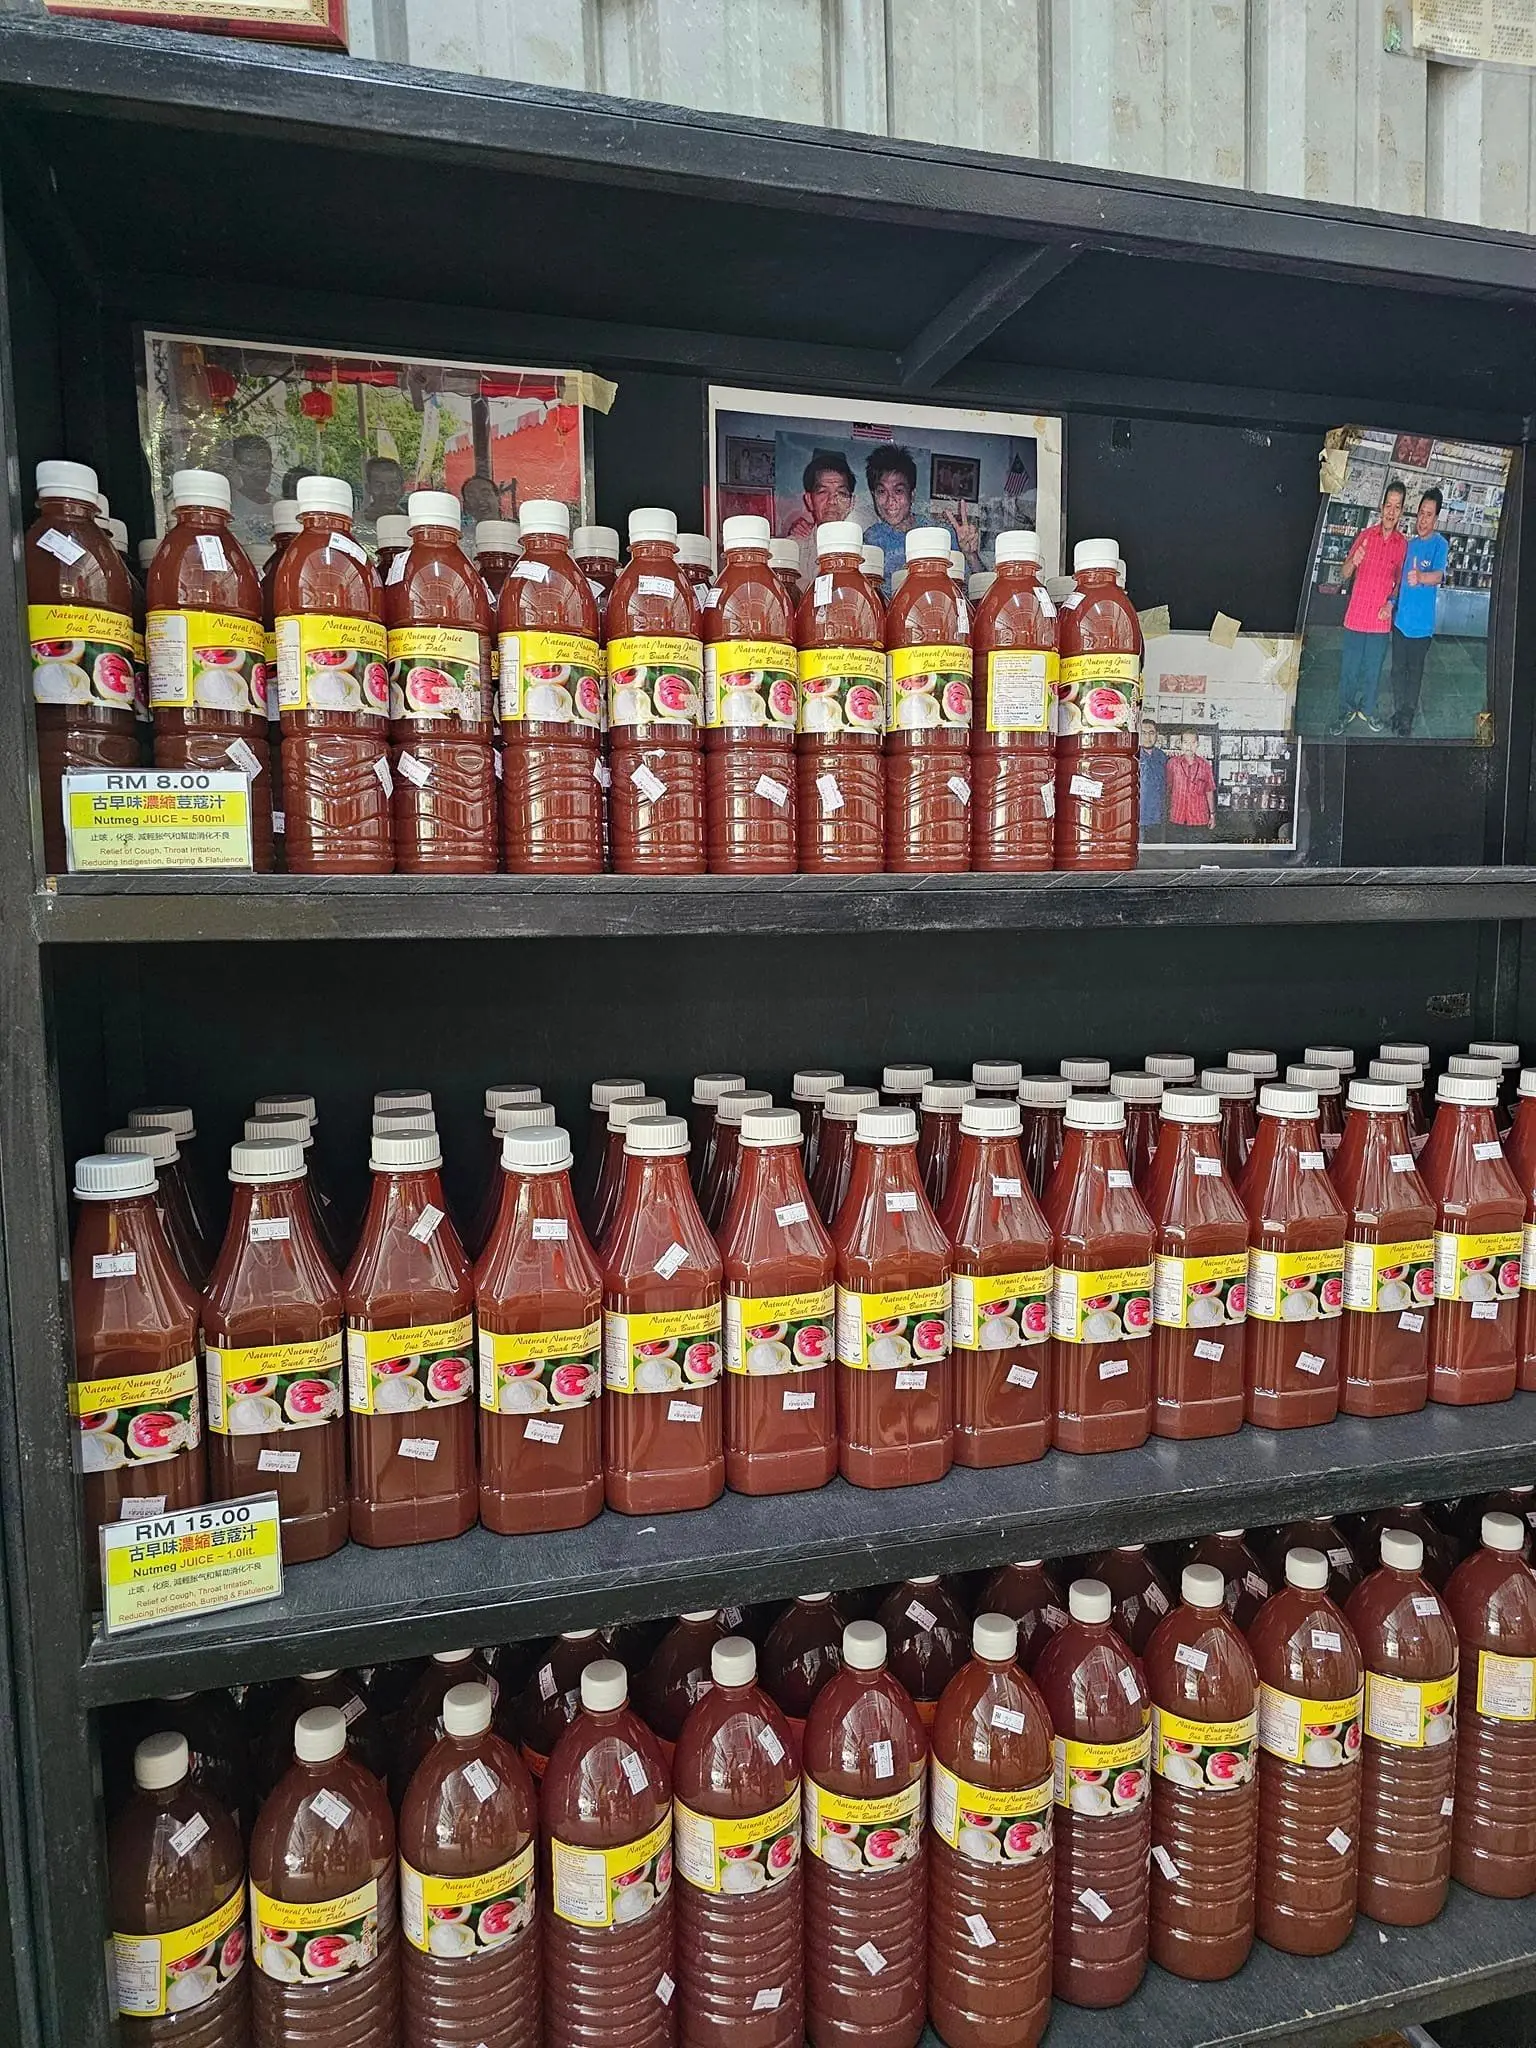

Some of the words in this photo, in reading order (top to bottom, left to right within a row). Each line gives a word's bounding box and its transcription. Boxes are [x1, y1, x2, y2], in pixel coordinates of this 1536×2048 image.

[46, 609, 88, 622] Natural
[90, 611, 122, 629] Nutmeg
[323, 619, 361, 633] Natural
[65, 623, 83, 635] Jus
[88, 625, 112, 637] Buah
[340, 634, 357, 645] Jus
[404, 631, 436, 645] Nutmeg
[438, 633, 463, 643] Juice
[425, 643, 447, 653] Pala
[619, 641, 650, 652] Natural
[651, 641, 682, 653] Nutmeg
[649, 652, 670, 661] Buah
[813, 652, 844, 662] Natural
[909, 650, 941, 660] Natural
[107, 775, 147, 790] RM
[156, 775, 210, 789] 8.00
[92, 795, 226, 811] 古早味濃縮荳蔻汁
[94, 815, 139, 826] Nutmeg
[142, 814, 178, 824] JUICE
[191, 814, 225, 823] 500ml
[100, 847, 123, 855] Relief
[125, 847, 133, 855] of
[134, 847, 162, 856] Cough,
[164, 846, 188, 854] Throat
[190, 846, 223, 854] Irritation,
[82, 859, 118, 867] Reducing
[121, 858, 164, 867] Indigestion,
[166, 857, 196, 866] Burping
[205, 856, 244, 864] Flatulence
[759, 1298, 791, 1310] Natural
[791, 1296, 819, 1308] Nutmeg
[880, 1294, 910, 1305] Natural
[911, 1291, 938, 1303] Nutmeg
[773, 1309, 787, 1319] Jus
[790, 1308, 808, 1316] Buah
[893, 1303, 907, 1313] Jus
[909, 1301, 927, 1309] Buah
[649, 1314, 681, 1326] Natural
[682, 1311, 711, 1324] Nutmeg
[387, 1330, 424, 1343] Natural
[425, 1326, 457, 1340] Nutmeg
[663, 1325, 678, 1335] Jus
[680, 1323, 700, 1332] Buah
[403, 1342, 419, 1352] Jus
[422, 1338, 443, 1348] Buah
[513, 1334, 548, 1346] Natural
[549, 1332, 582, 1345] Nutmeg
[243, 1350, 282, 1363] Natural
[284, 1346, 319, 1359] Nutmeg
[529, 1346, 544, 1356] Jus
[548, 1343, 568, 1353] Buah
[261, 1360, 276, 1372] Jus
[281, 1358, 304, 1368] Buah
[308, 1354, 328, 1365] Pala
[80, 1383, 121, 1397] Natural
[123, 1377, 161, 1391] Nutmeg
[163, 1368, 187, 1385] Juice
[98, 1393, 116, 1406] Jus
[121, 1390, 145, 1401] Buah
[149, 1386, 172, 1397] Pala
[136, 1520, 175, 1541] RM
[185, 1507, 250, 1532] 15.00
[129, 1525, 258, 1562] 古早味濃縮荳蔻汁
[133, 1563, 177, 1578] Nutmeg
[180, 1553, 214, 1569] JUICE
[228, 1547, 256, 1559] 1.0lit.
[136, 1597, 158, 1608] Relief
[160, 1595, 168, 1604] of
[169, 1590, 197, 1602] Cough,
[199, 1585, 222, 1596] Throat
[223, 1578, 254, 1591] Irritation,
[118, 1608, 154, 1622] Reducing
[156, 1600, 199, 1615] Indigestion,
[200, 1593, 229, 1606] Burping
[230, 1590, 236, 1598] &
[237, 1584, 274, 1597] Flatulence
[1176, 1720, 1205, 1731] Natural
[1084, 1745, 1114, 1755] Natural
[976, 1792, 1006, 1802] Natural
[1007, 1792, 1034, 1804] Nutmeg
[833, 1799, 863, 1811] Natural
[864, 1799, 892, 1812] Nutmeg
[987, 1803, 1001, 1812] Jus
[1004, 1803, 1022, 1812] Buah
[845, 1811, 859, 1820] Jus
[862, 1811, 882, 1820] Buah
[441, 1879, 476, 1891] Natural
[477, 1870, 508, 1888] Nutmeg
[455, 1891, 472, 1902] Jus
[474, 1886, 496, 1899] Buah
[270, 1902, 301, 1917] Natural
[302, 1902, 337, 1917] Nutmeg
[337, 1894, 361, 1909] Juice
[283, 1915, 297, 1925] Jus
[300, 1915, 322, 1925] Buah
[325, 1911, 346, 1922] Pala
